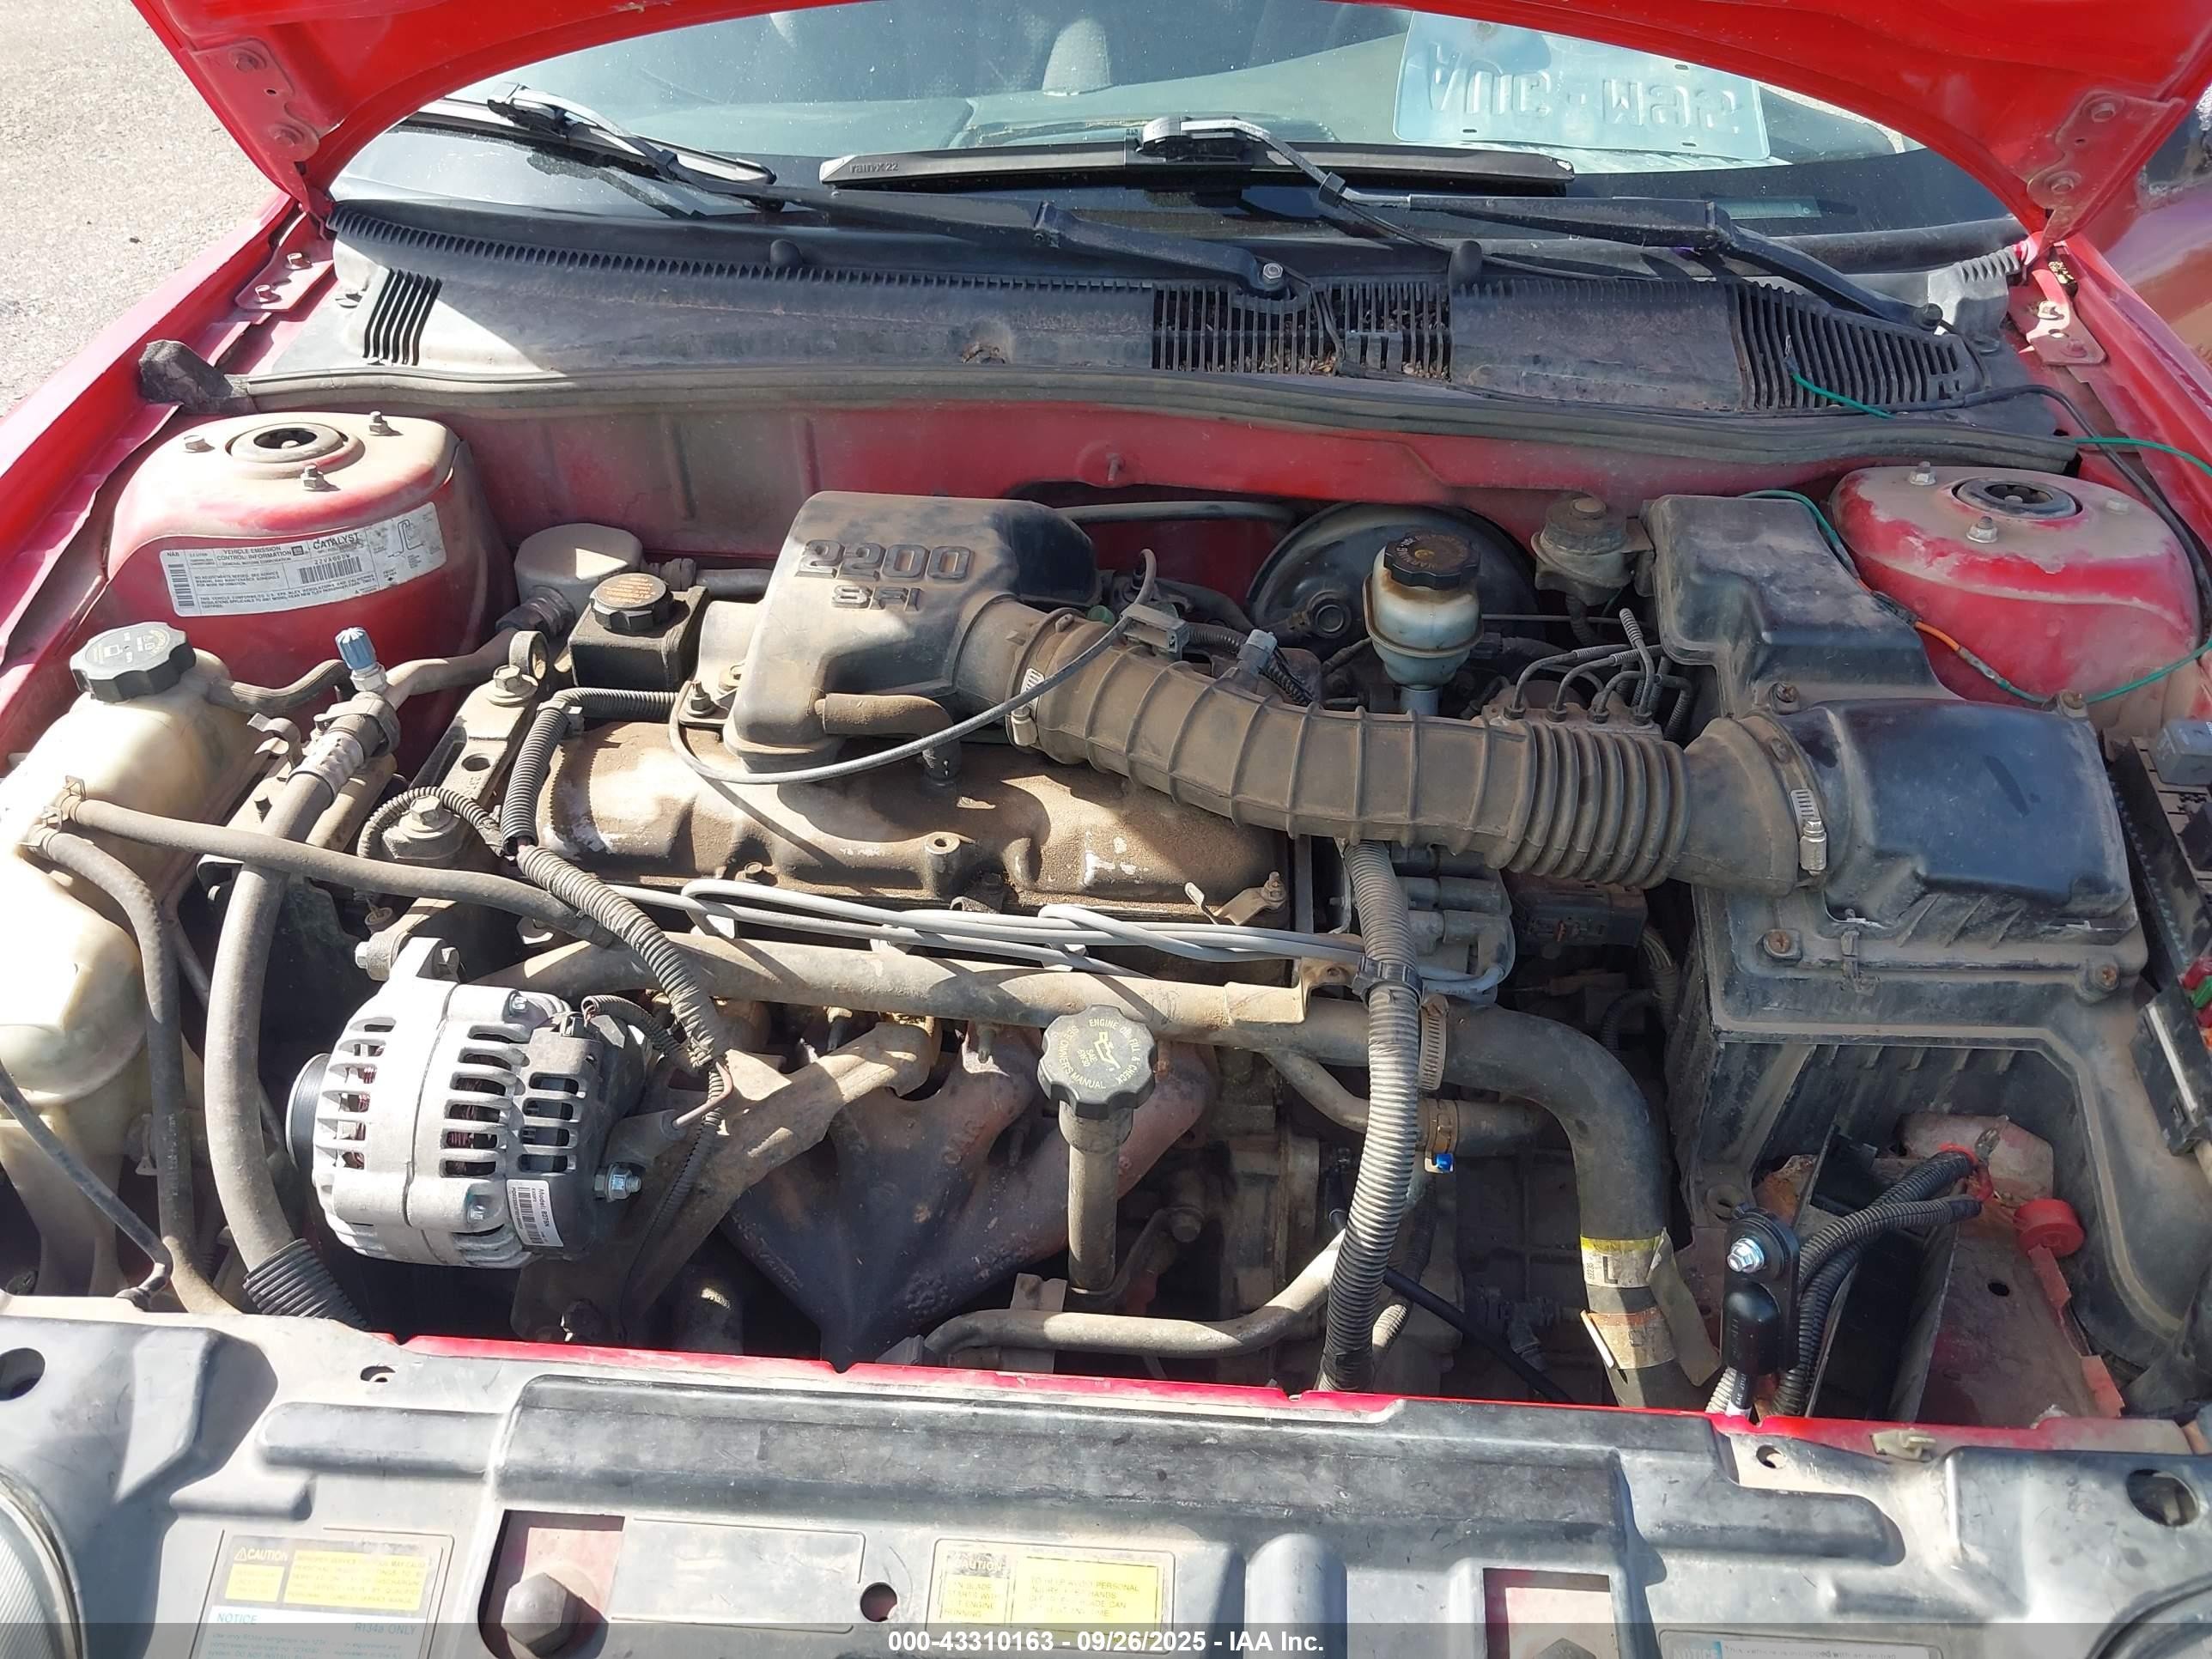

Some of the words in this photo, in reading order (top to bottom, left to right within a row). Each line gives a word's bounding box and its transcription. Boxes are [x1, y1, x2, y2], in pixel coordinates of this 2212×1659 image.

[885, 162, 900, 172] 22
[313, 532, 359, 550] CATALYST
[248, 550, 292, 559] INFORMATION
[250, 545, 282, 554] EMISSION
[794, 539, 975, 583] 2200
[831, 585, 924, 611] SFI
[1063, 1025, 1079, 1041] SEE
[1089, 1018, 1120, 1030] ENGINE
[1115, 1065, 1138, 1085] CHECK
[1070, 1072, 1107, 1089] MANUAL
[1602, 1255, 1619, 1285] L
[246, 1548, 289, 1562] CAUTION
[1096, 1581, 1140, 1592] PERSONAL
[1109, 1601, 1127, 1609] CAN
[216, 1613, 258, 1625] NOTICE
[387, 1624, 418, 1636] ONLY
